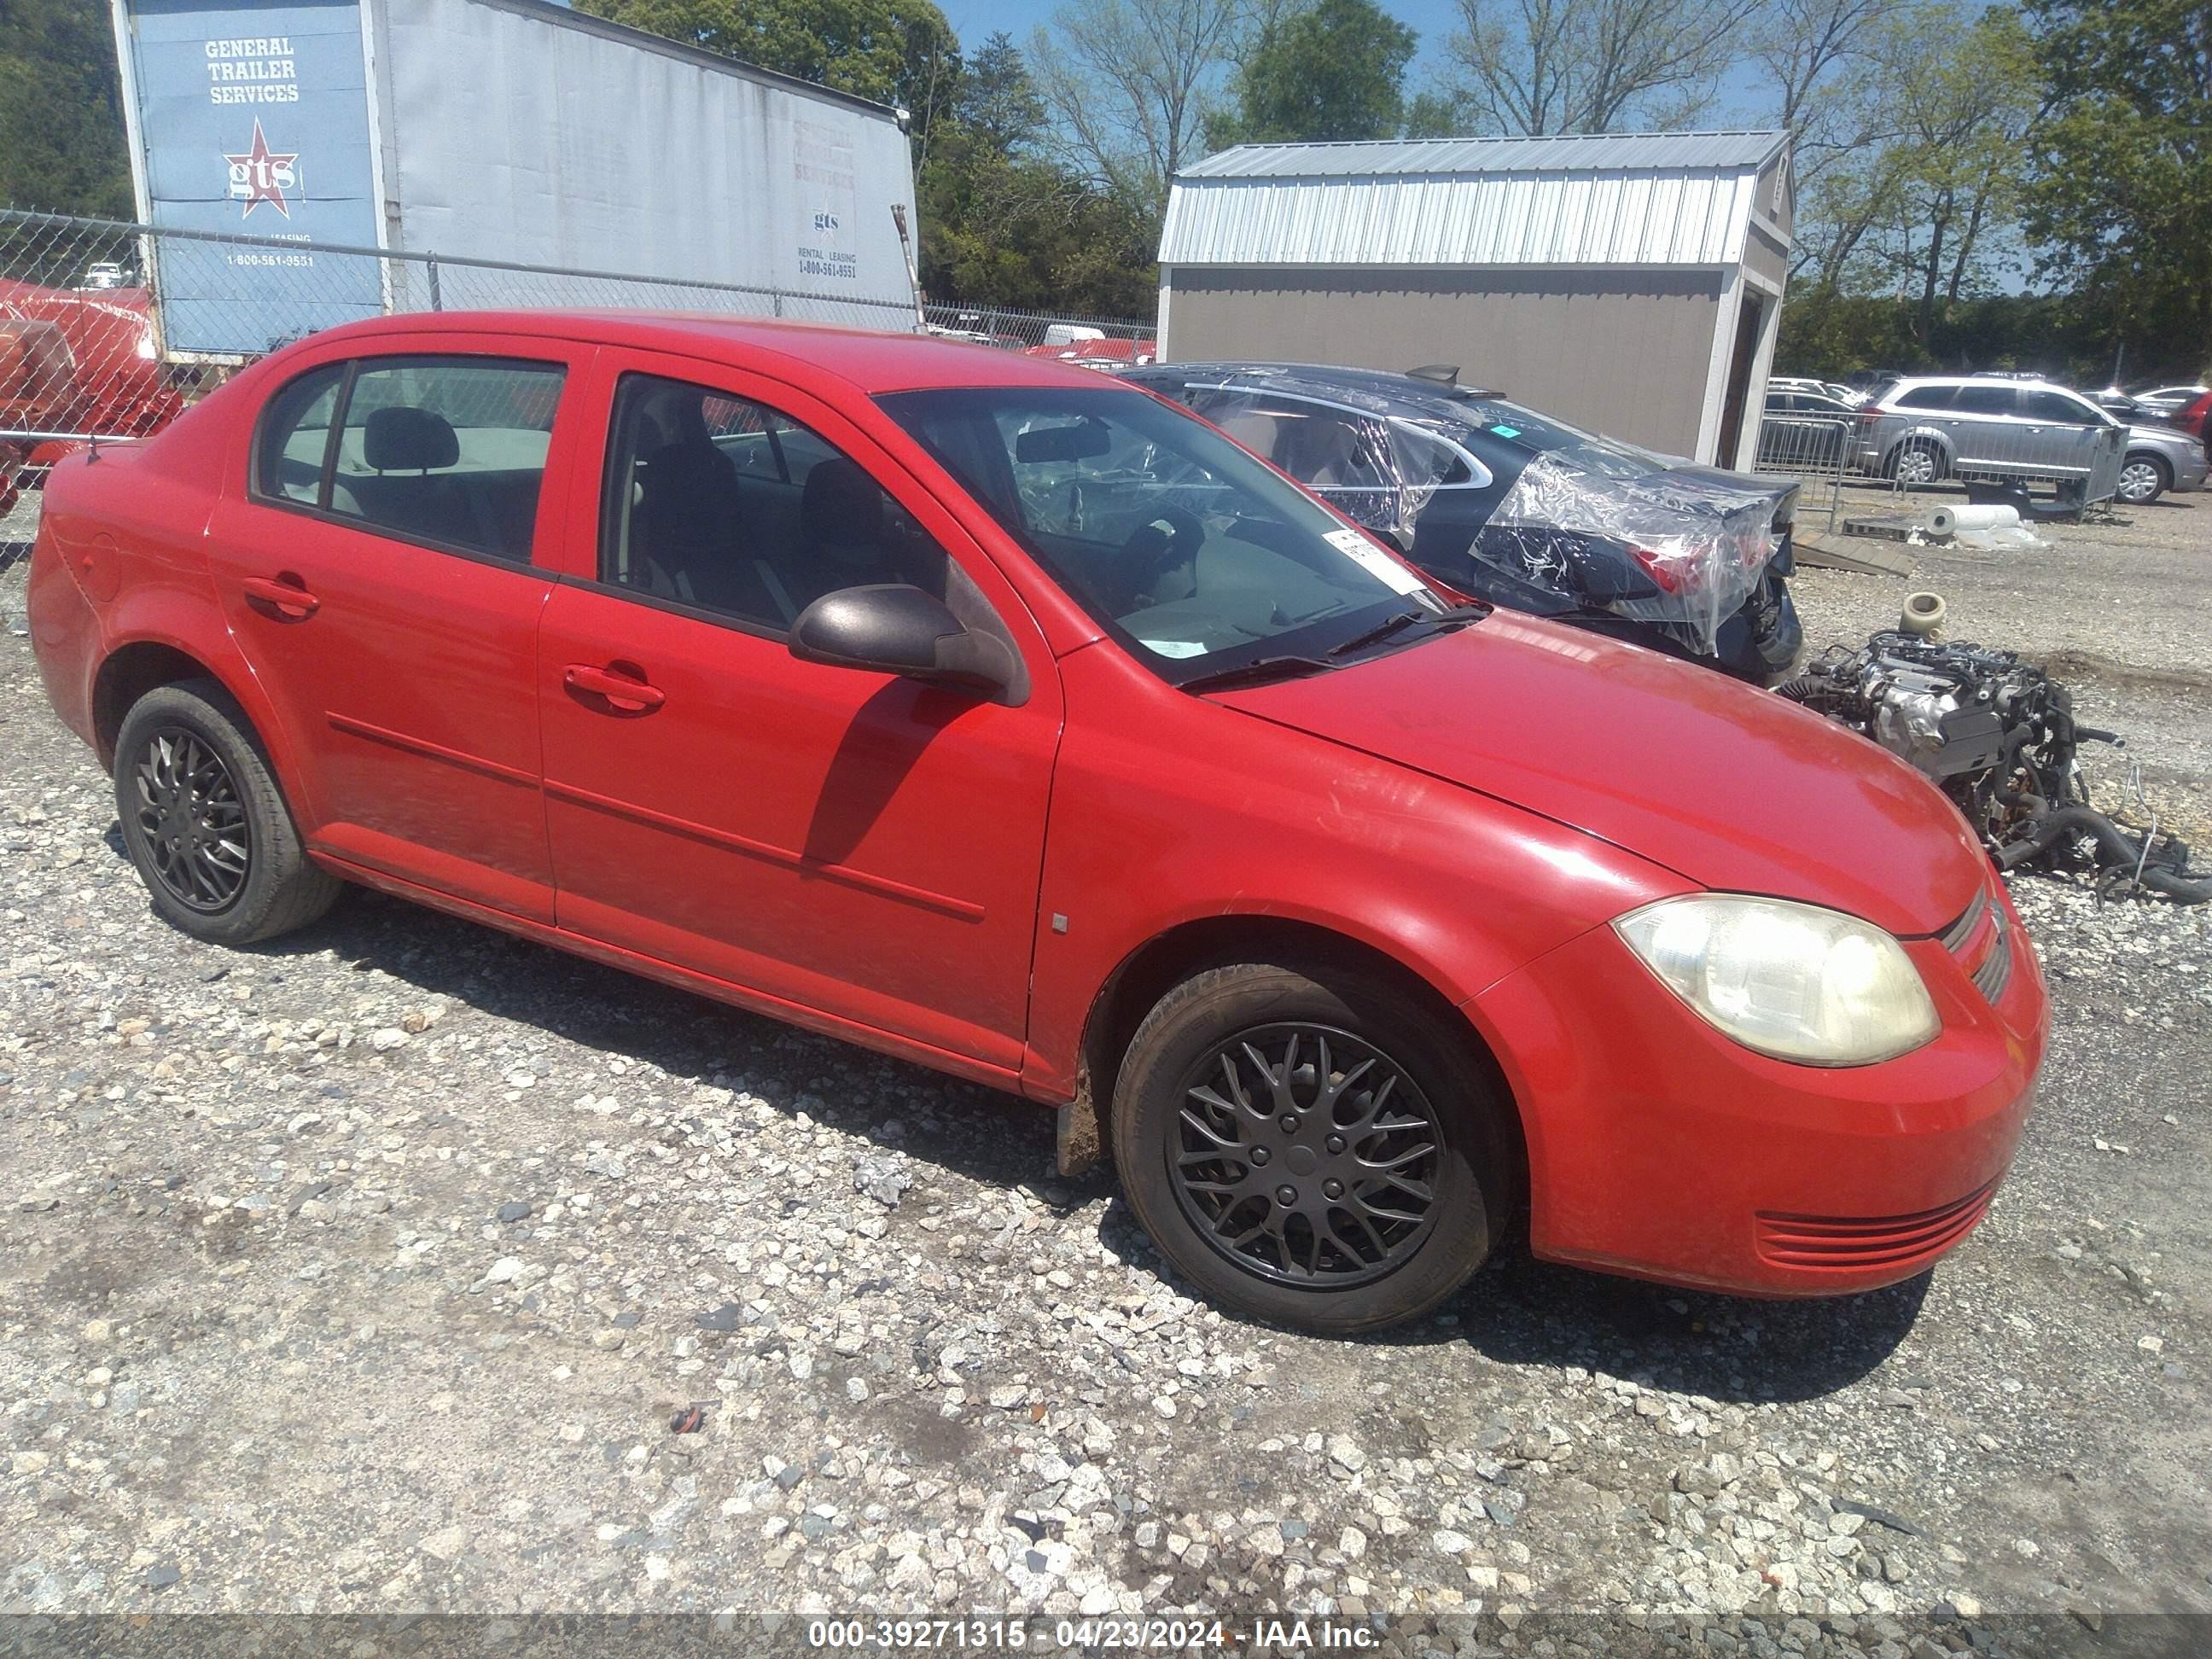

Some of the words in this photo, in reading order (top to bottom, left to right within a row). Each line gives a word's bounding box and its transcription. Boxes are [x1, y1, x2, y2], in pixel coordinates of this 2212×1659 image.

[206, 38, 294, 58] GENERAL
[207, 60, 295, 81] TRAILER
[210, 84, 299, 104] SERVICES
[229, 155, 295, 200] gts
[814, 213, 838, 232] gts
[227, 255, 314, 267] 1-800-561-9551
[798, 247, 824, 260] RENTAL
[829, 251, 857, 264] LEASING
[800, 259, 856, 278] 1-800-561-9551
